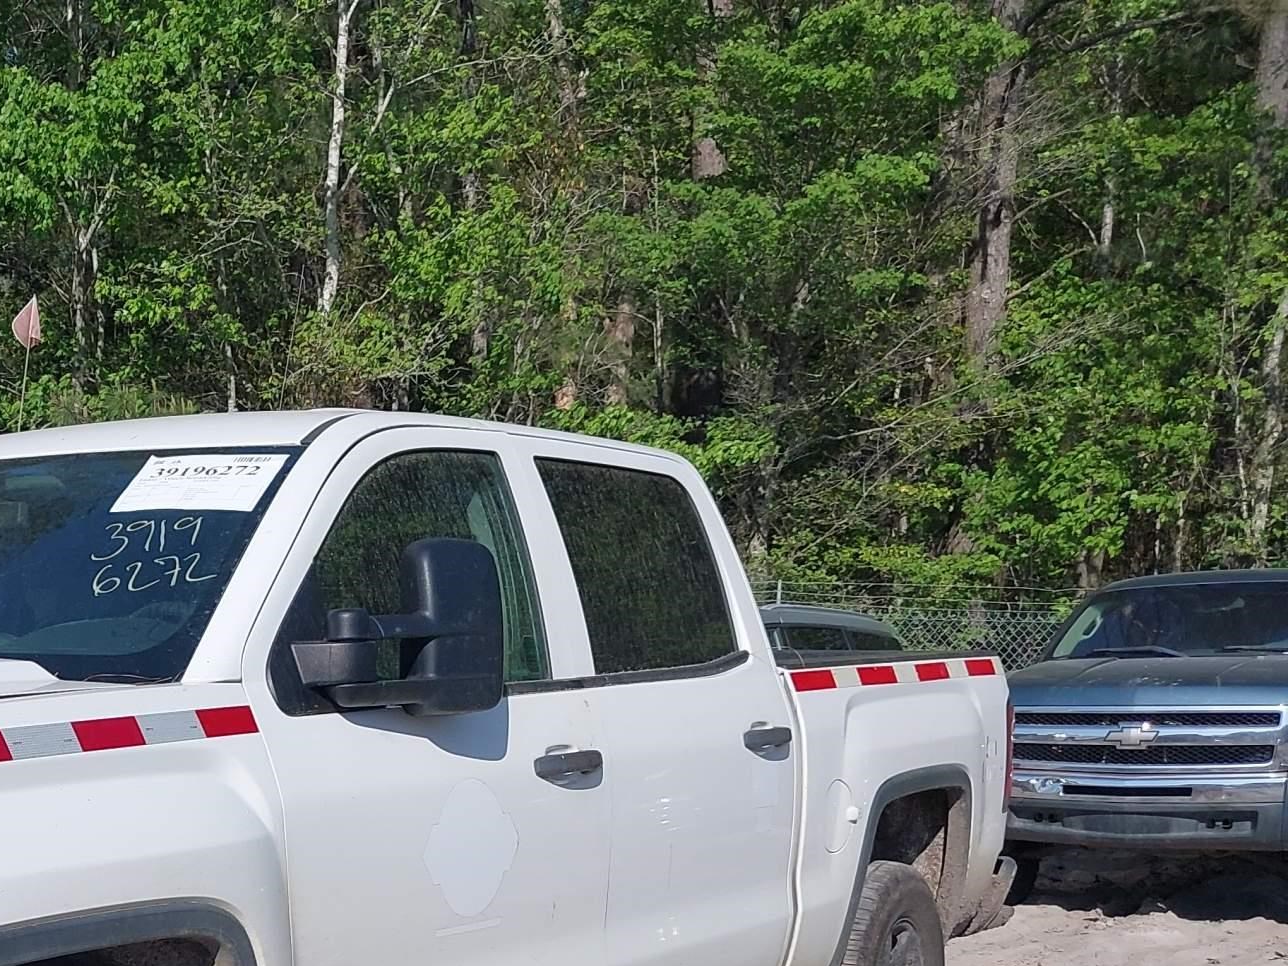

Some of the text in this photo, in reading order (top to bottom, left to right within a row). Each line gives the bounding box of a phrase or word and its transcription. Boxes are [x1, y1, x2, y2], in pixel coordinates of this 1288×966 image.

[149, 465, 261, 479] 39196272
[91, 516, 203, 561] 3919
[92, 552, 217, 597] 6272
